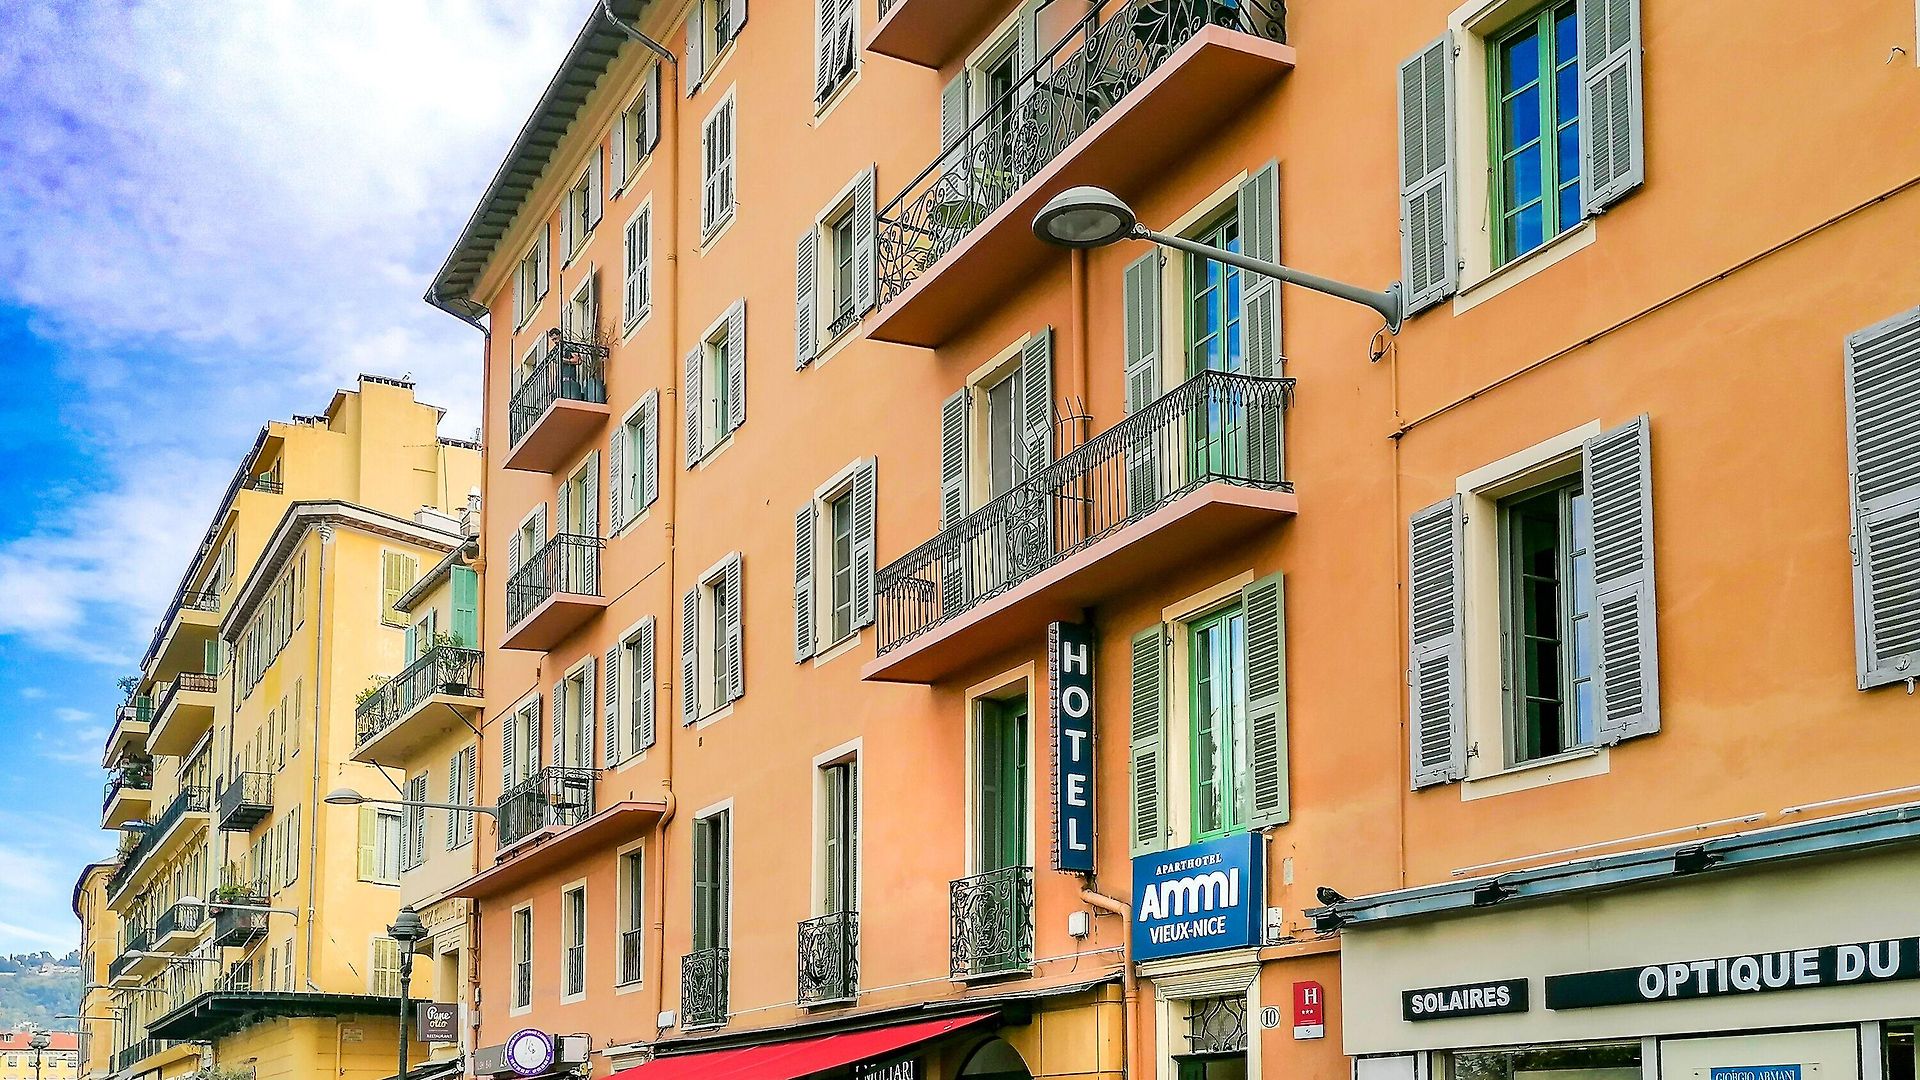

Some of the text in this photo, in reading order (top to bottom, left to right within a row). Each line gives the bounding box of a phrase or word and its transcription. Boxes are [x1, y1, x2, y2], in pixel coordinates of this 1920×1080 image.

[1062, 641, 1090, 851] HOTEL
[1156, 853, 1223, 876] APARTHOTEL
[1150, 916, 1227, 944] VIEUX-NICE
[1638, 949, 1820, 999] OPTIQUE
[1836, 940, 1900, 981] DU
[1303, 987, 1318, 1005] H
[1411, 985, 1510, 1014] SOLAIRES
[1265, 1010, 1276, 1025] 10
